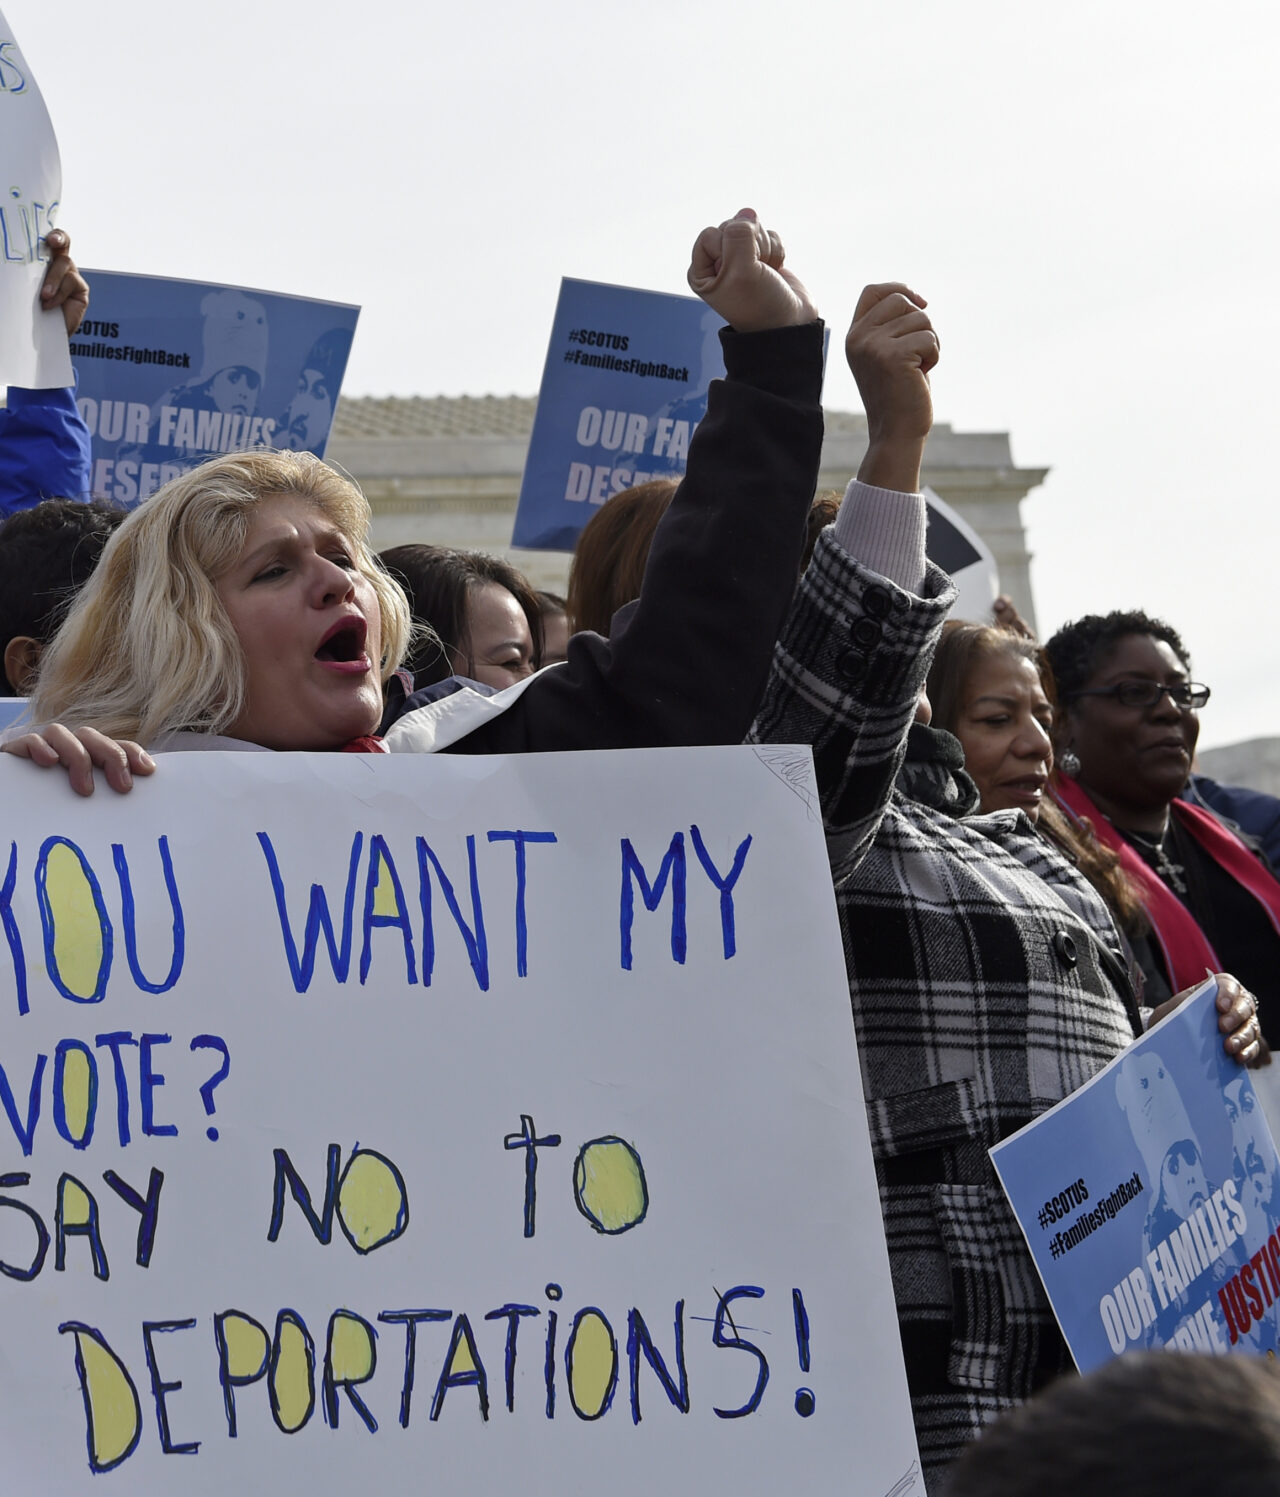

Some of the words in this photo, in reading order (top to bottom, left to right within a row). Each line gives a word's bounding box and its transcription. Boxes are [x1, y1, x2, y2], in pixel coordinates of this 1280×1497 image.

[69, 341, 191, 369] amiliesFightBack
[74, 319, 119, 338] COTUS
[568, 329, 629, 351] #SCOTUS
[564, 351, 689, 382] #FamiliesFightBack
[77, 397, 149, 445] OUR
[158, 405, 276, 452] FAMILIES
[576, 406, 649, 454] OUR
[256, 830, 557, 993] WANT
[619, 824, 753, 970] MY
[267, 1141, 408, 1255] NO
[1038, 1178, 1089, 1230] #SCOTUS
[1049, 1171, 1144, 1261] #FamiliesFightBack
[1100, 1266, 1157, 1355] OUR
[1146, 1178, 1248, 1311] FAMILIES
[1217, 1224, 1280, 1346] JUSTIC
